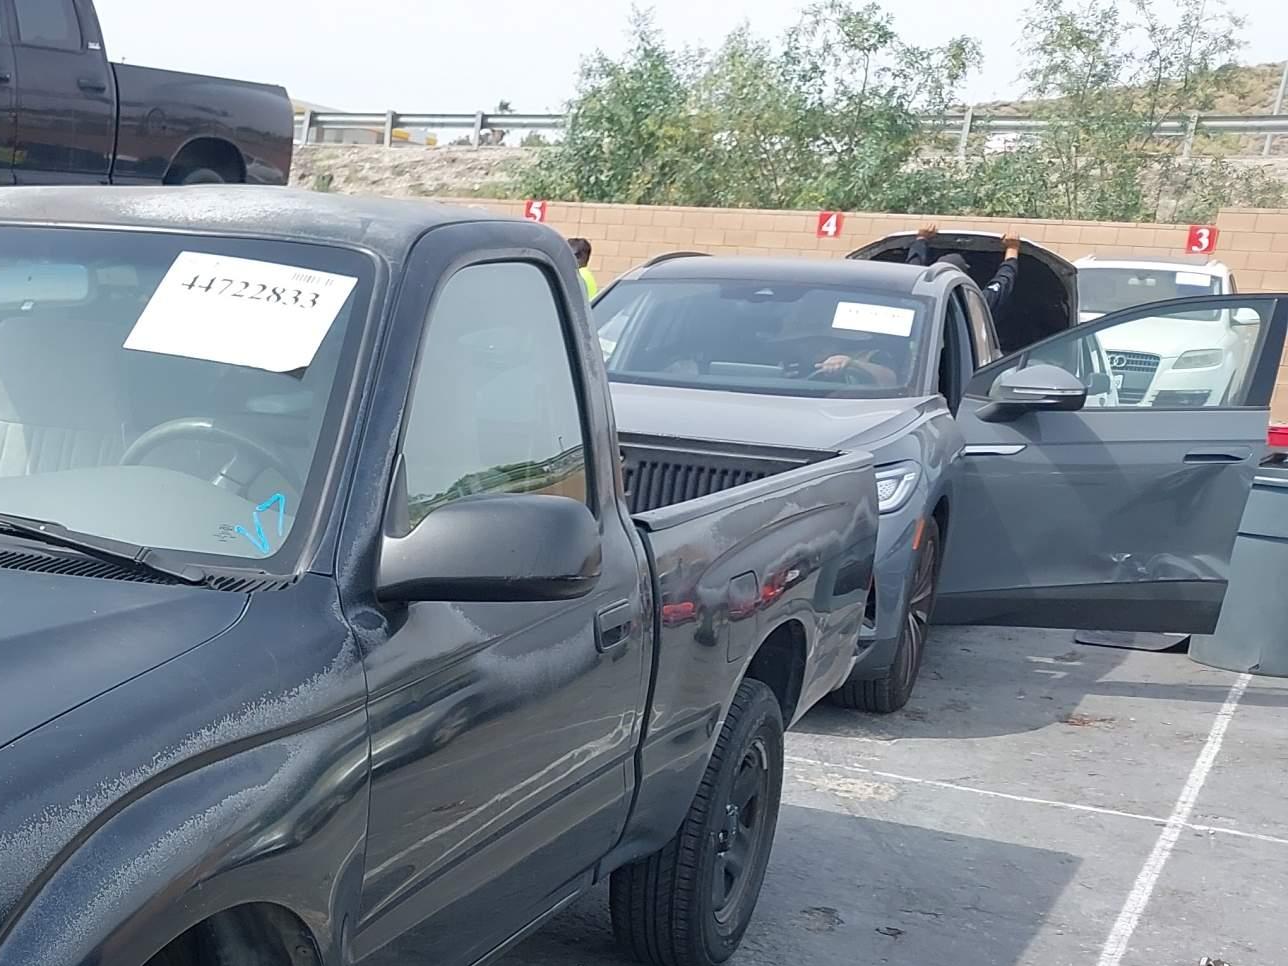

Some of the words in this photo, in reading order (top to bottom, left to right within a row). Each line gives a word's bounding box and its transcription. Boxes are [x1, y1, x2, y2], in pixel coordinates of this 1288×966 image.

[526, 201, 542, 222] 5
[821, 213, 838, 237] 4
[1191, 228, 1210, 252] 3
[180, 274, 320, 309] 44722833
